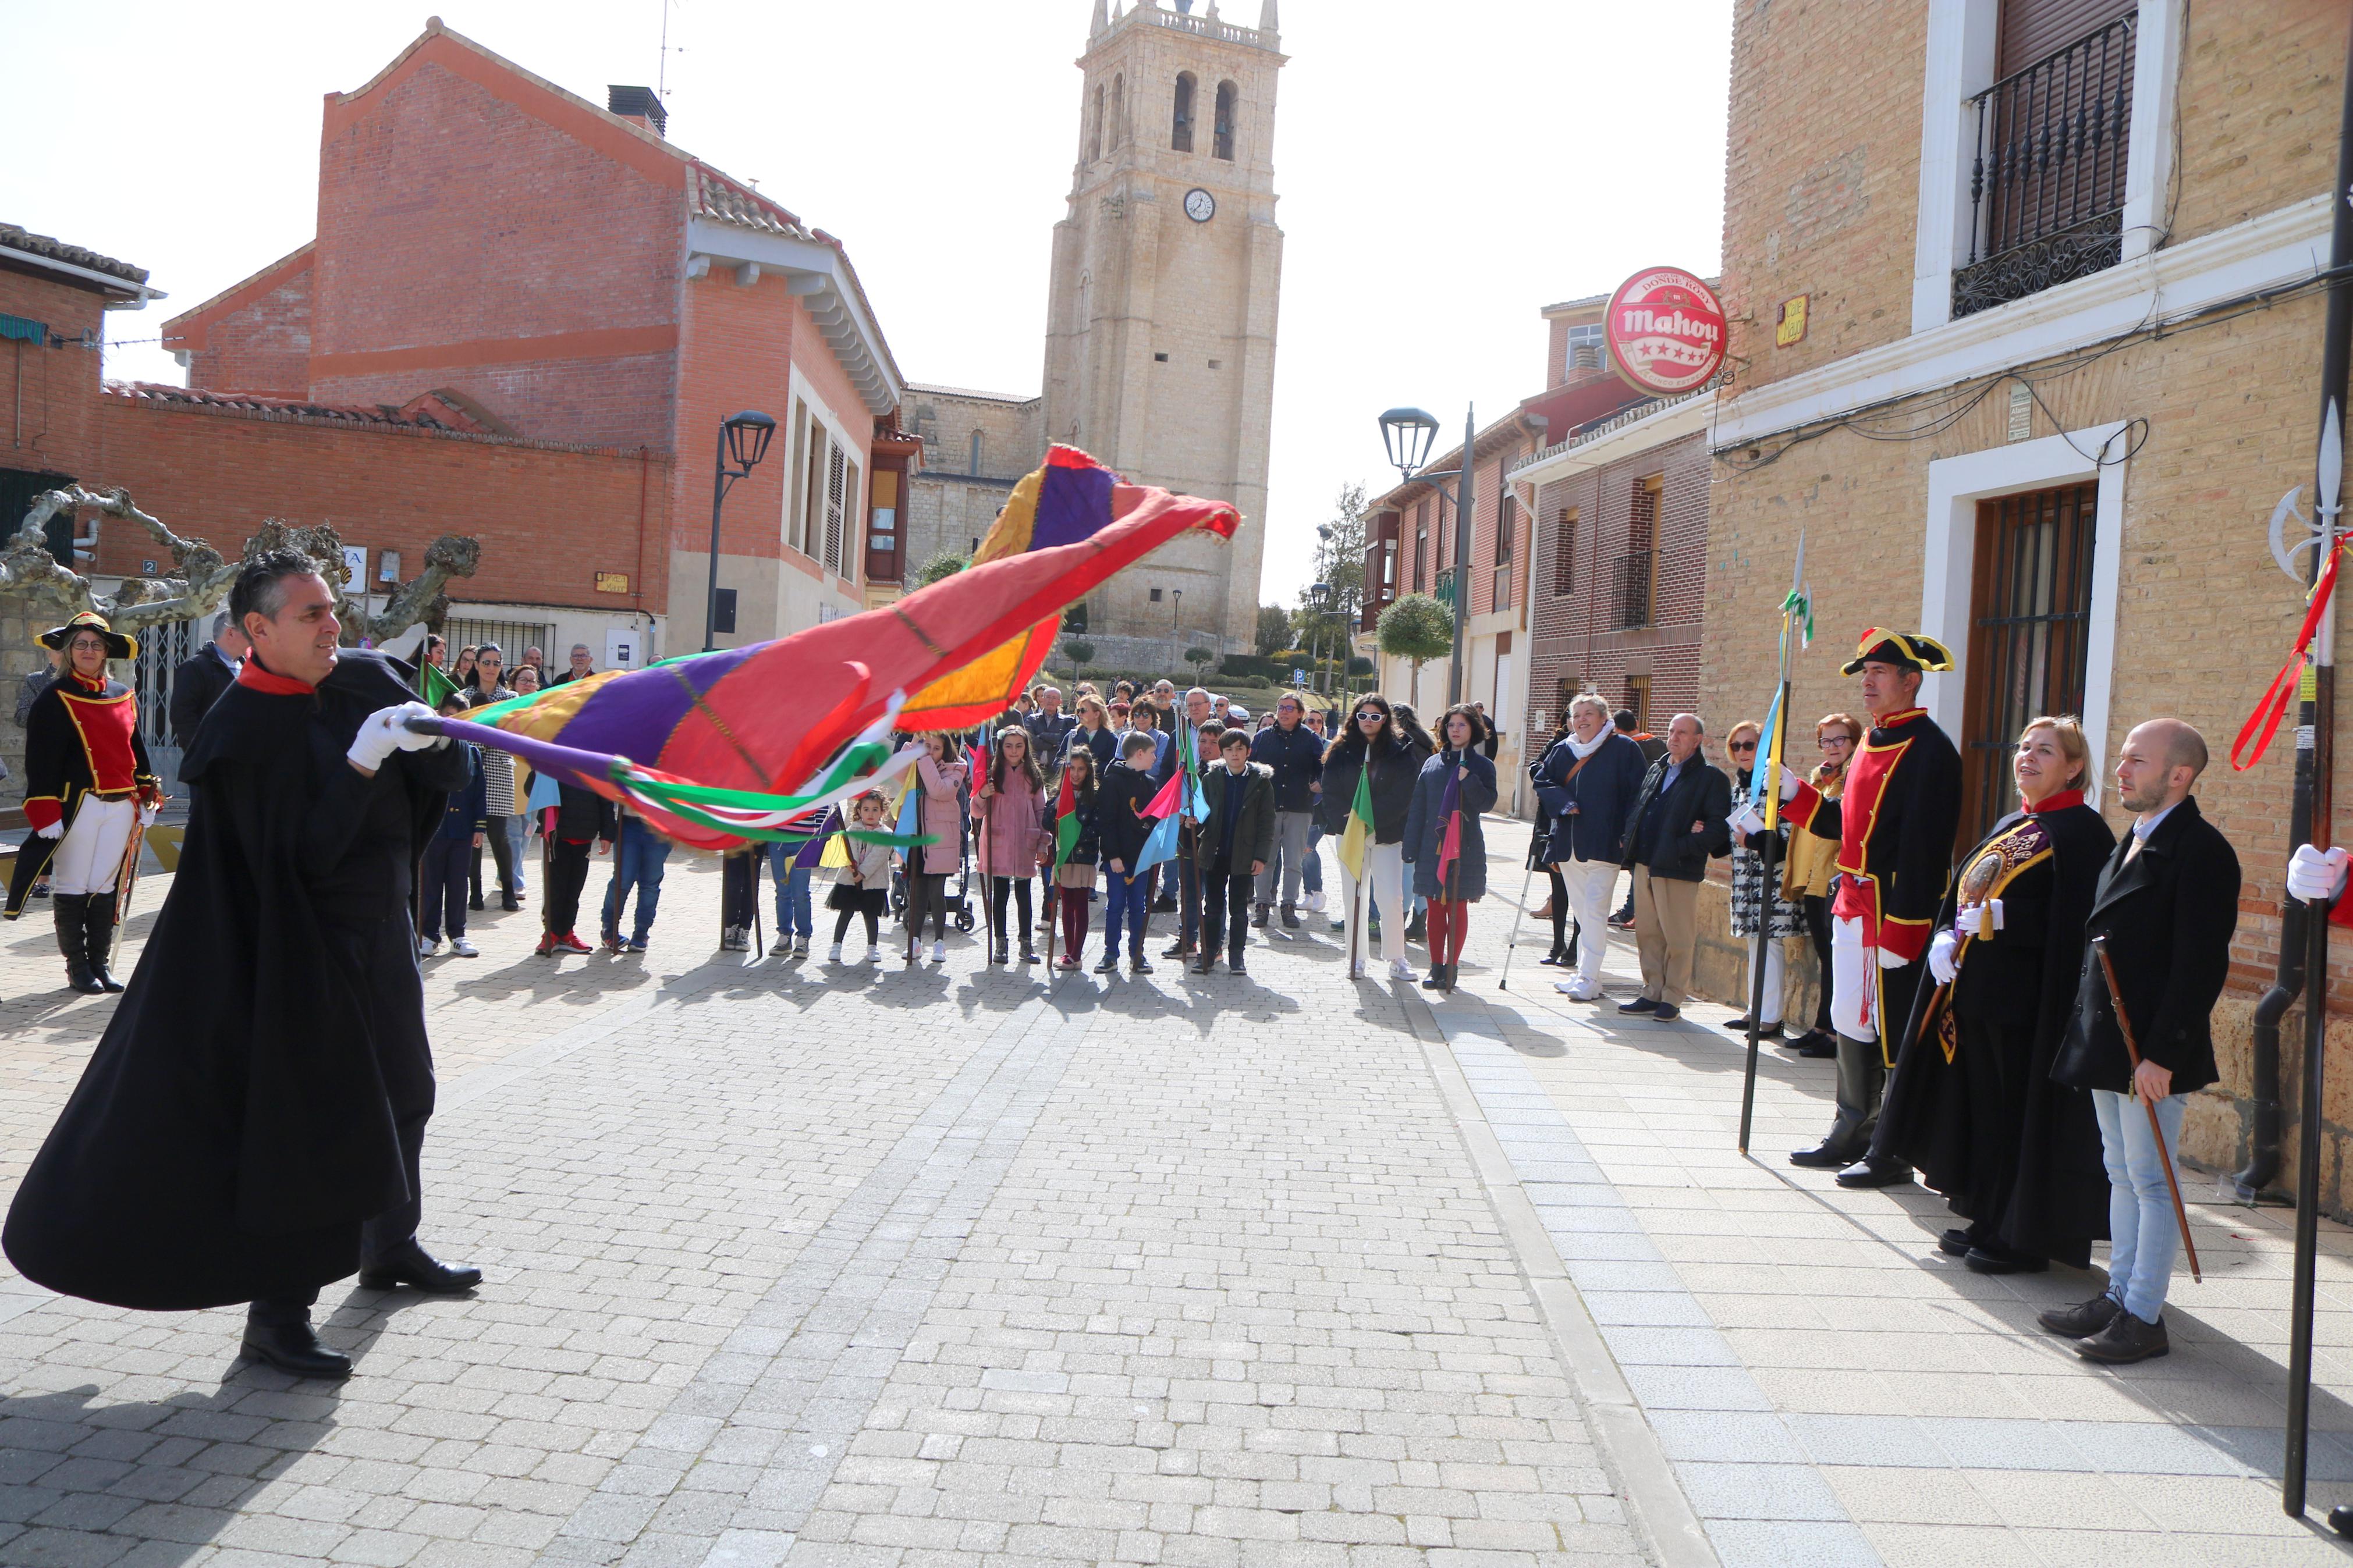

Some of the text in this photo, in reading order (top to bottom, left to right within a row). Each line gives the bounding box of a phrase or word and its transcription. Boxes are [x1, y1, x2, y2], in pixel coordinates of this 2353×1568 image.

[1642, 277, 1710, 304] DONDE ROSY
[1787, 301, 1802, 318] Calle
[1623, 310, 1719, 342] Mahou
[1783, 319, 1804, 341] Mayor
[1648, 360, 1715, 386] CINCO ESTRELLAS
[147, 562, 154, 571] 2
[1297, 671, 1303, 681] P
